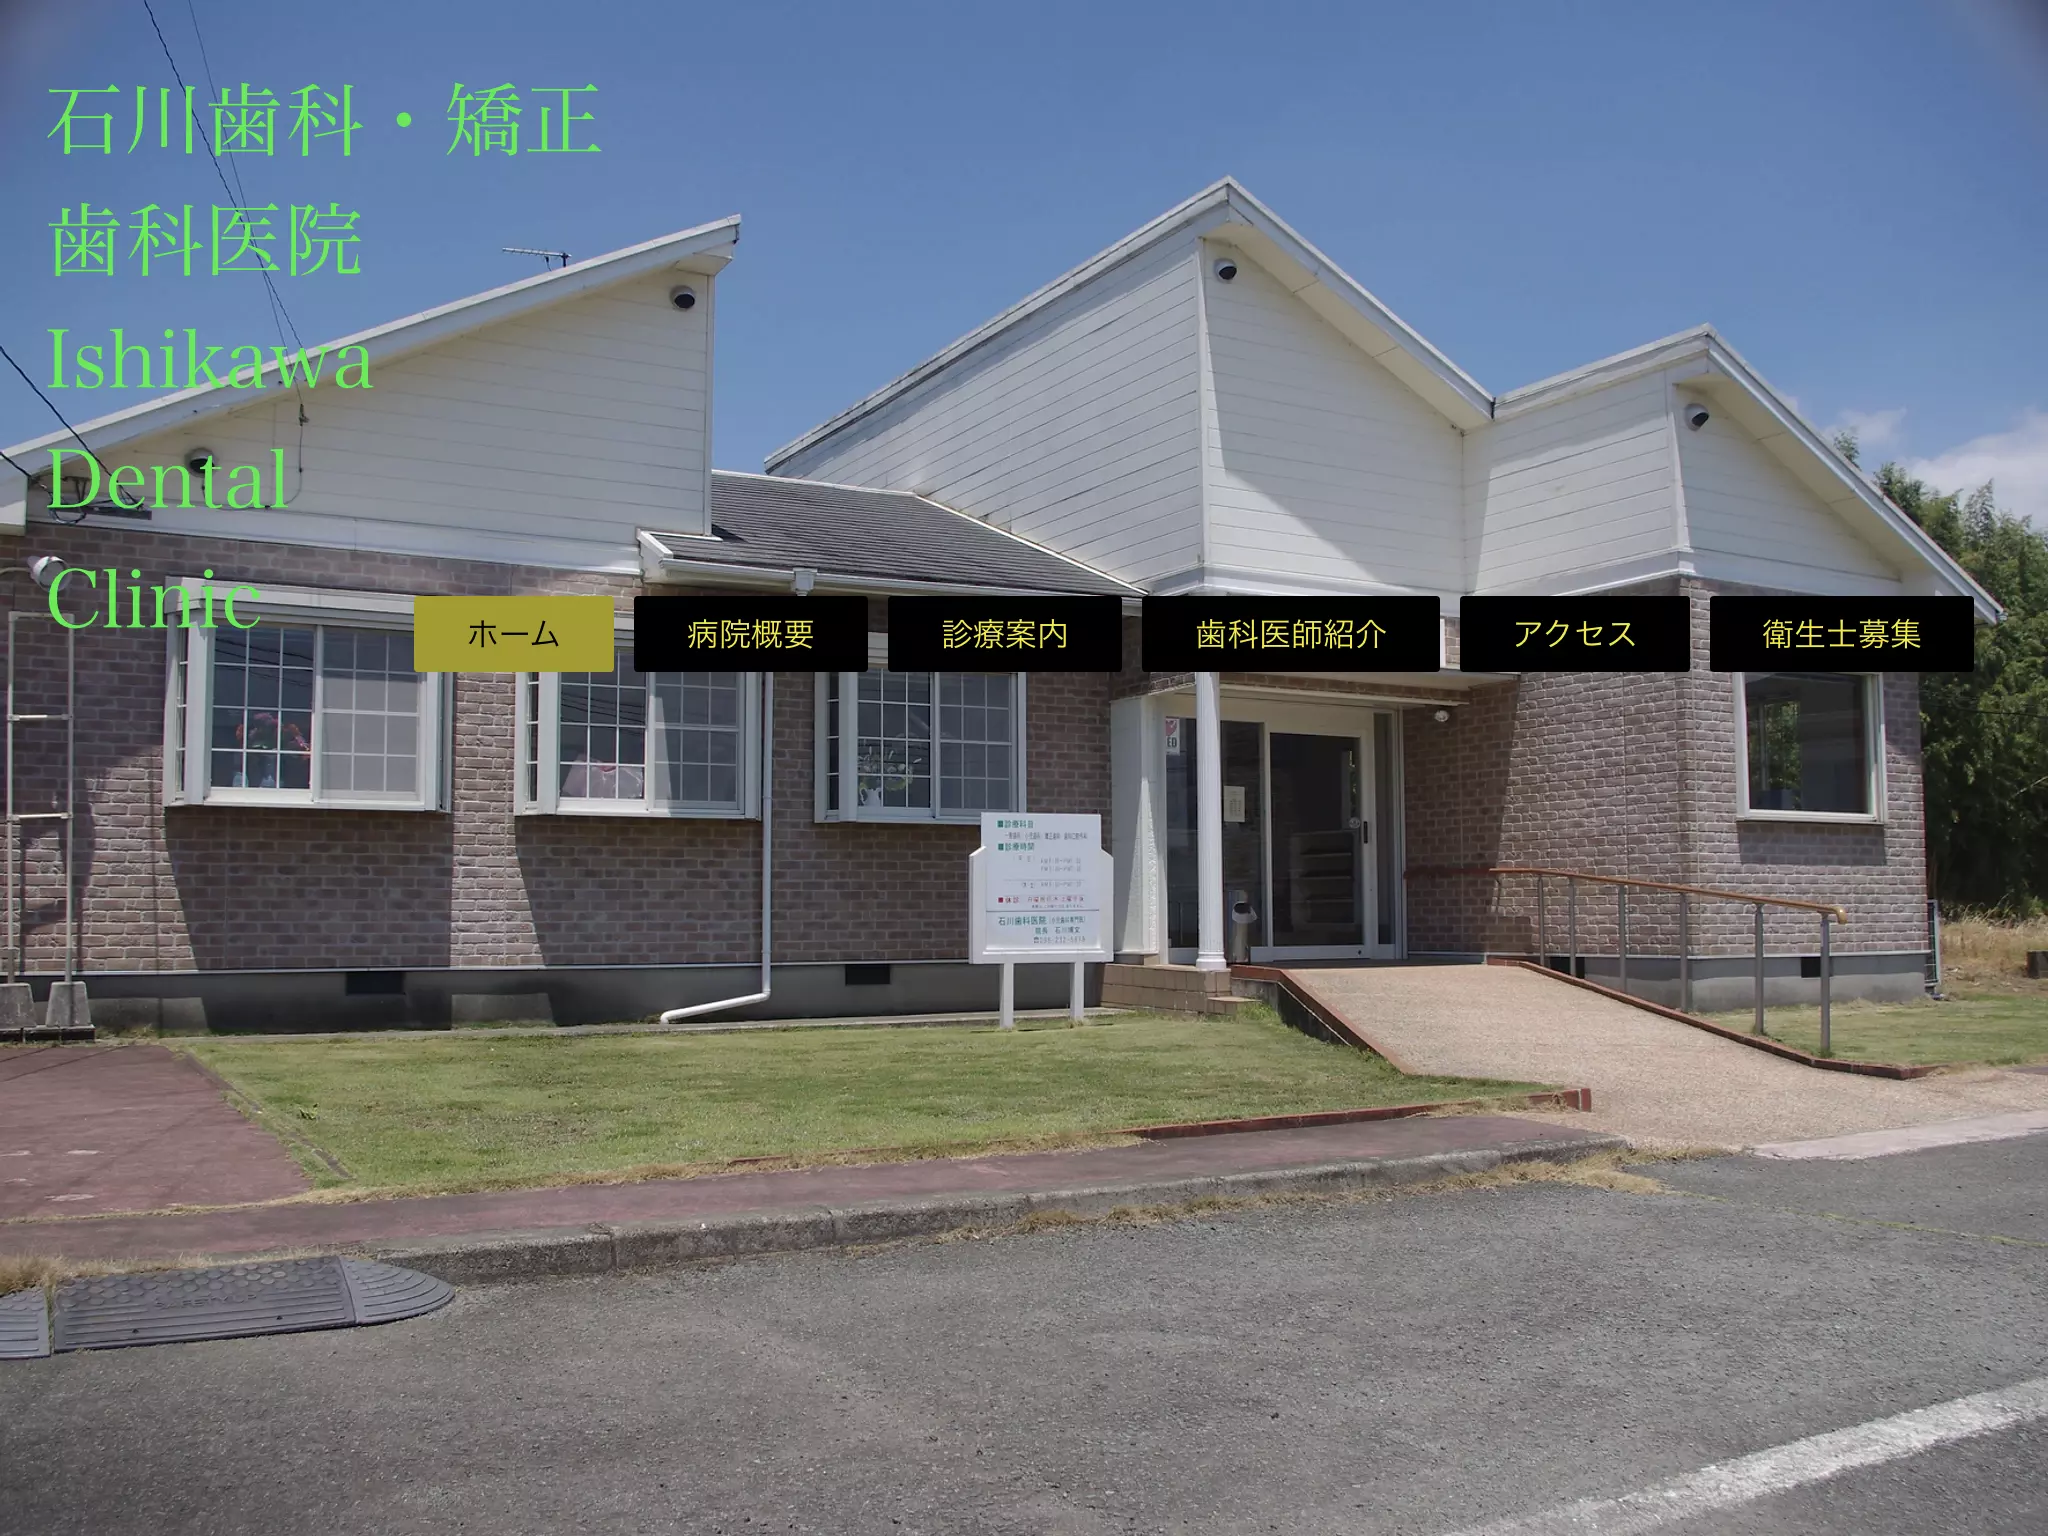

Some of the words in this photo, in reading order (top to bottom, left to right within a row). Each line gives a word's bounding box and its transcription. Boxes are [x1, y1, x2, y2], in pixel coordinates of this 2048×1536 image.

[1166, 736, 1177, 748] ED
[998, 916, 1048, 926] 石川歯科医院
